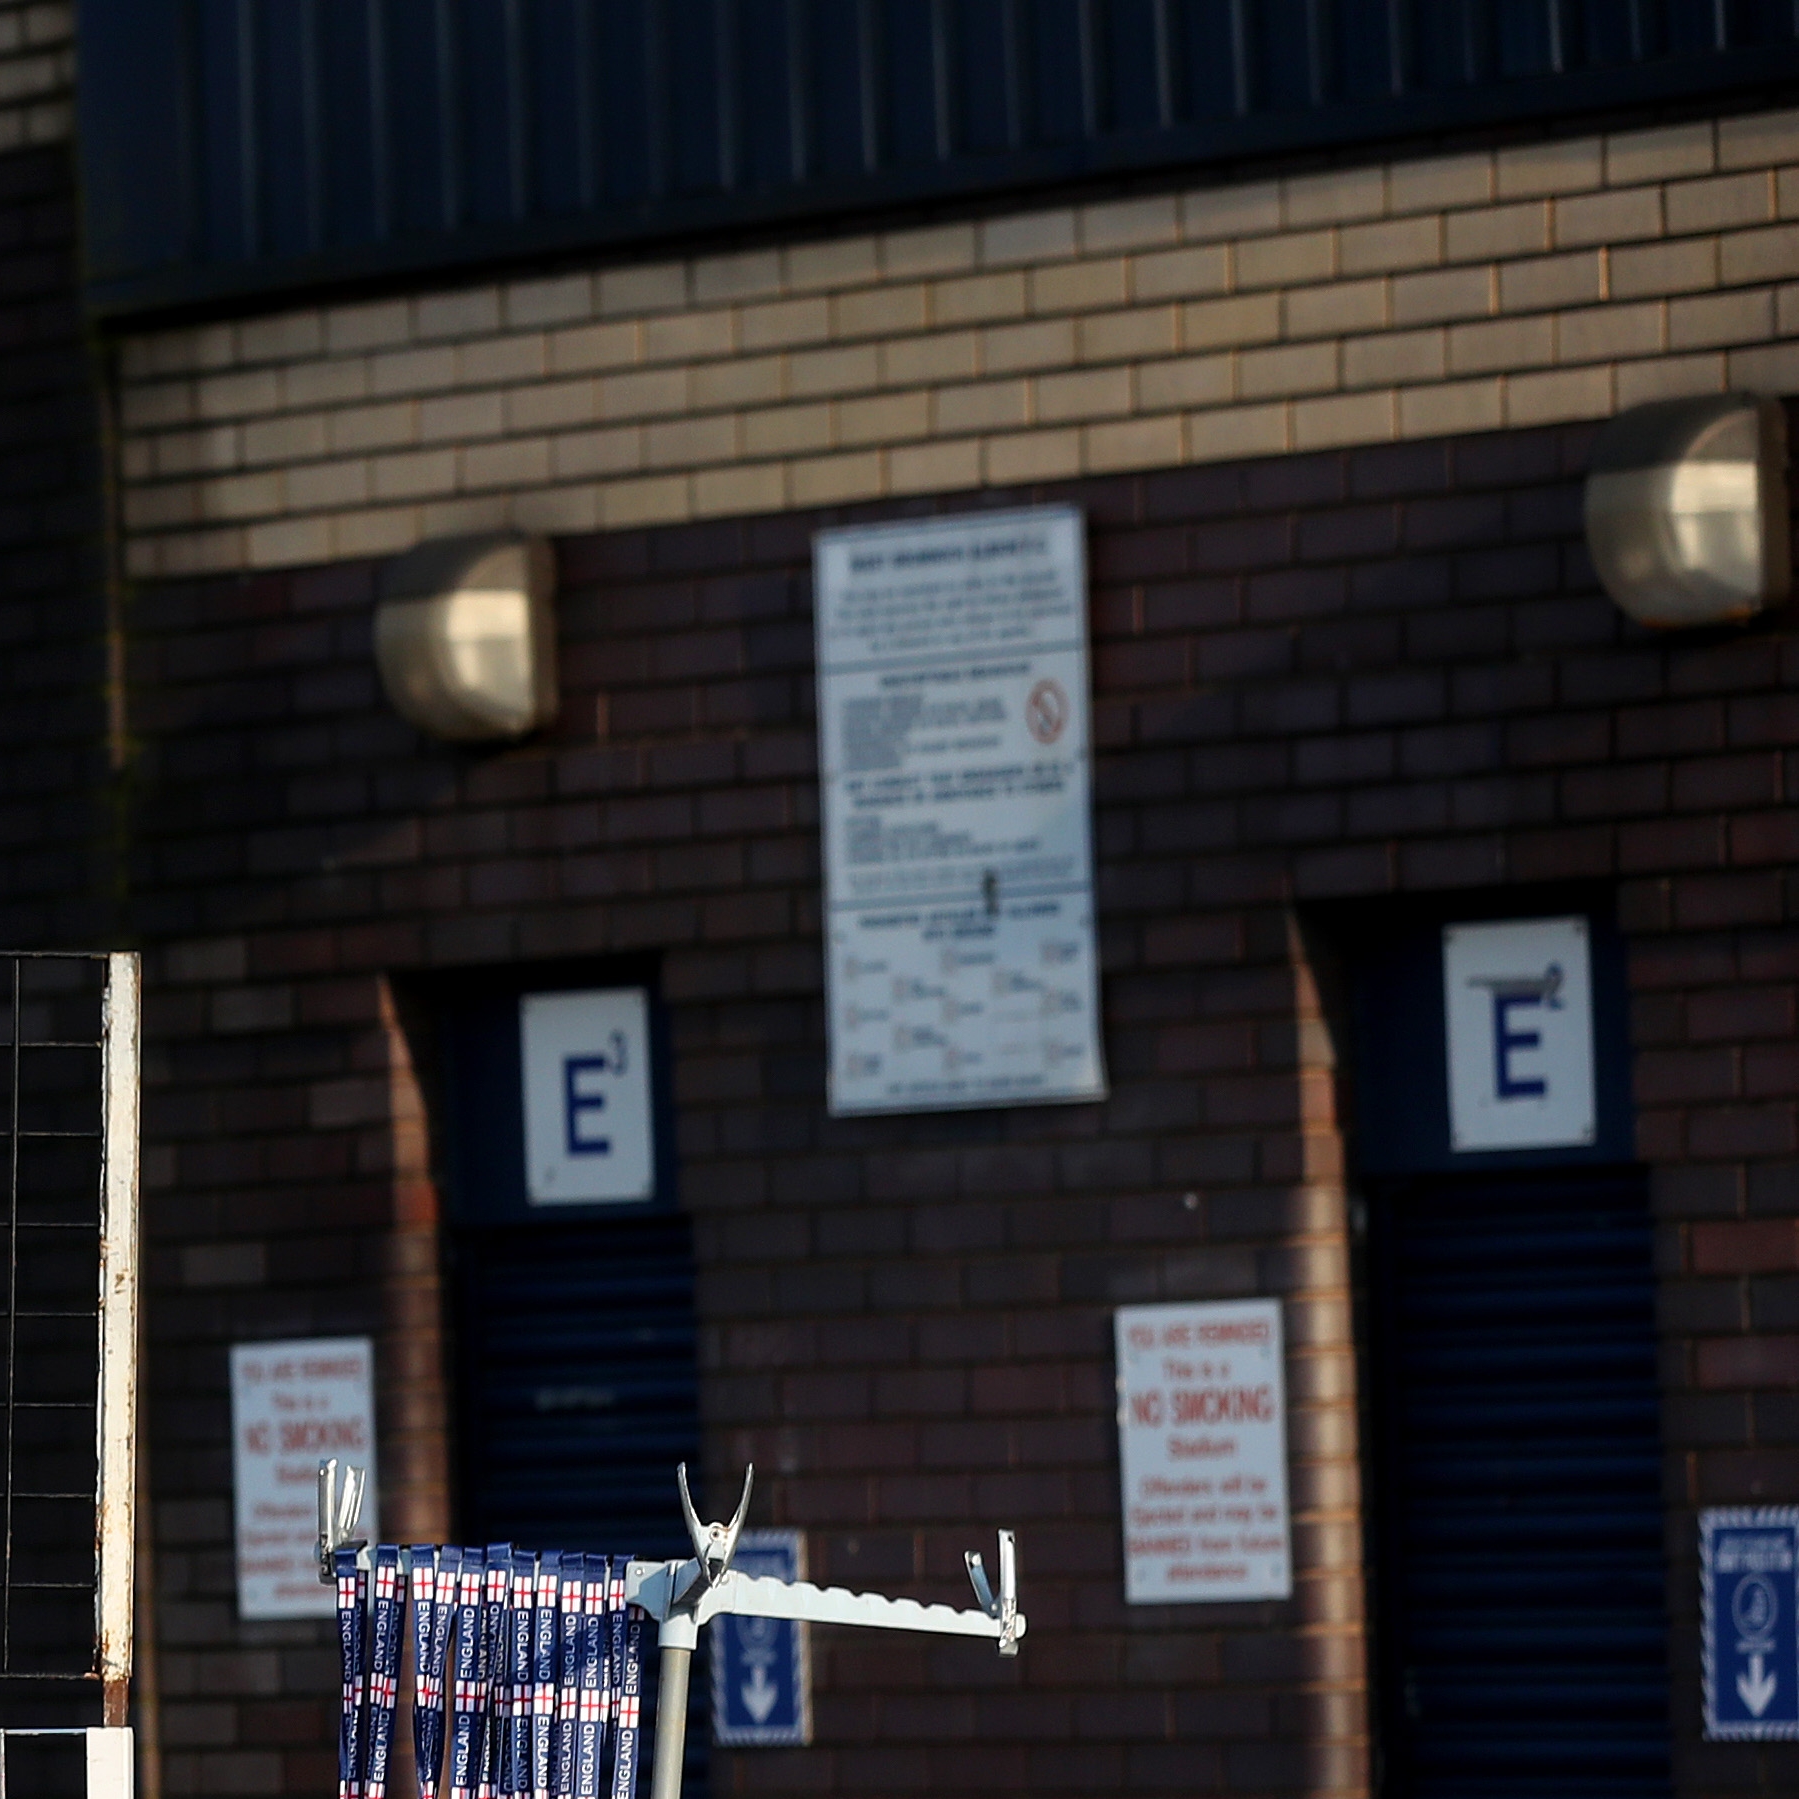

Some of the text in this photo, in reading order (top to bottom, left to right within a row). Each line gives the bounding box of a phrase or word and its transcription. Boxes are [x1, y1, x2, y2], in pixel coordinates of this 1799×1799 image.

[374, 1601, 389, 1671] ENGLAND
[431, 1606, 447, 1676] ENGLAND
[460, 1607, 475, 1679] ENGLAND
[517, 1610, 529, 1681] ENGLAND
[538, 1609, 552, 1680] ENGLAND
[564, 1615, 577, 1686] ENGLAND
[586, 1616, 599, 1688] ENGLAND
[456, 1715, 470, 1786] ENGLAND
[537, 1715, 550, 1786] ENGLAND
[561, 1721, 572, 1792] ENGLAND
[581, 1724, 596, 1796] ENGLAND
